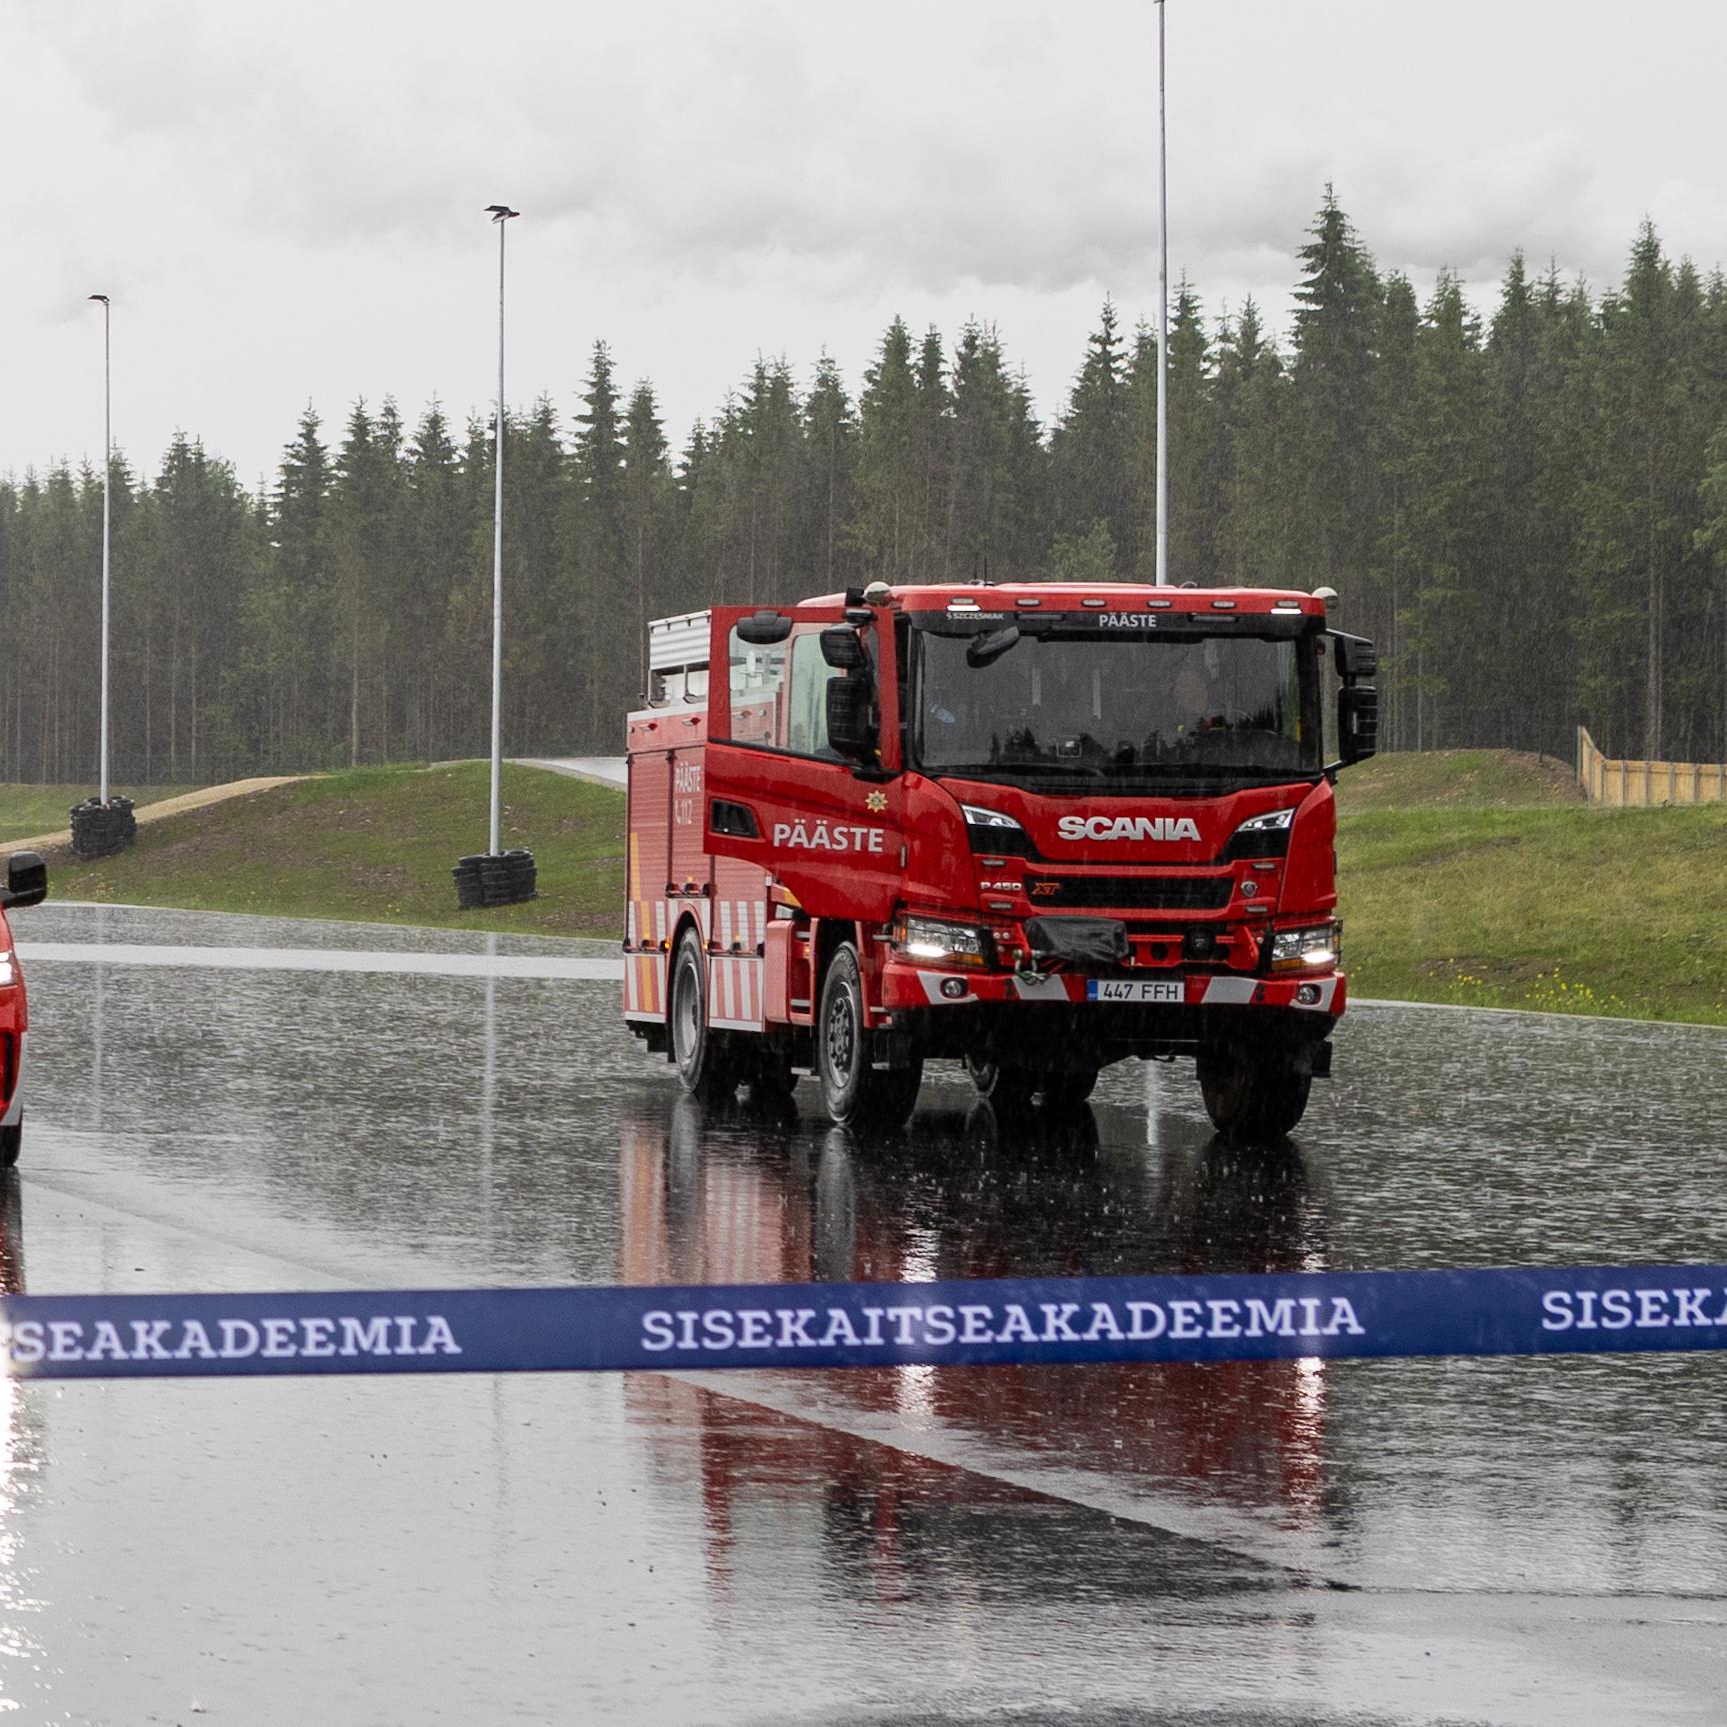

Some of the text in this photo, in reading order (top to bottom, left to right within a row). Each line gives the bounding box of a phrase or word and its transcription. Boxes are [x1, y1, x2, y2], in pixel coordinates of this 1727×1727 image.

[1099, 612, 1157, 628] PÄÄSTE
[675, 761, 701, 793] PÄÄSTE
[773, 818, 884, 852] PÄÄSTE
[1057, 816, 1202, 841] SCANIA
[980, 881, 1022, 891] P 450
[1032, 882, 1060, 896] XT
[1103, 983, 1178, 1000] 447 FFH
[1541, 1288, 1727, 1330] SISEK
[640, 1297, 1365, 1351] SISEKAITSEAKADEEMIA
